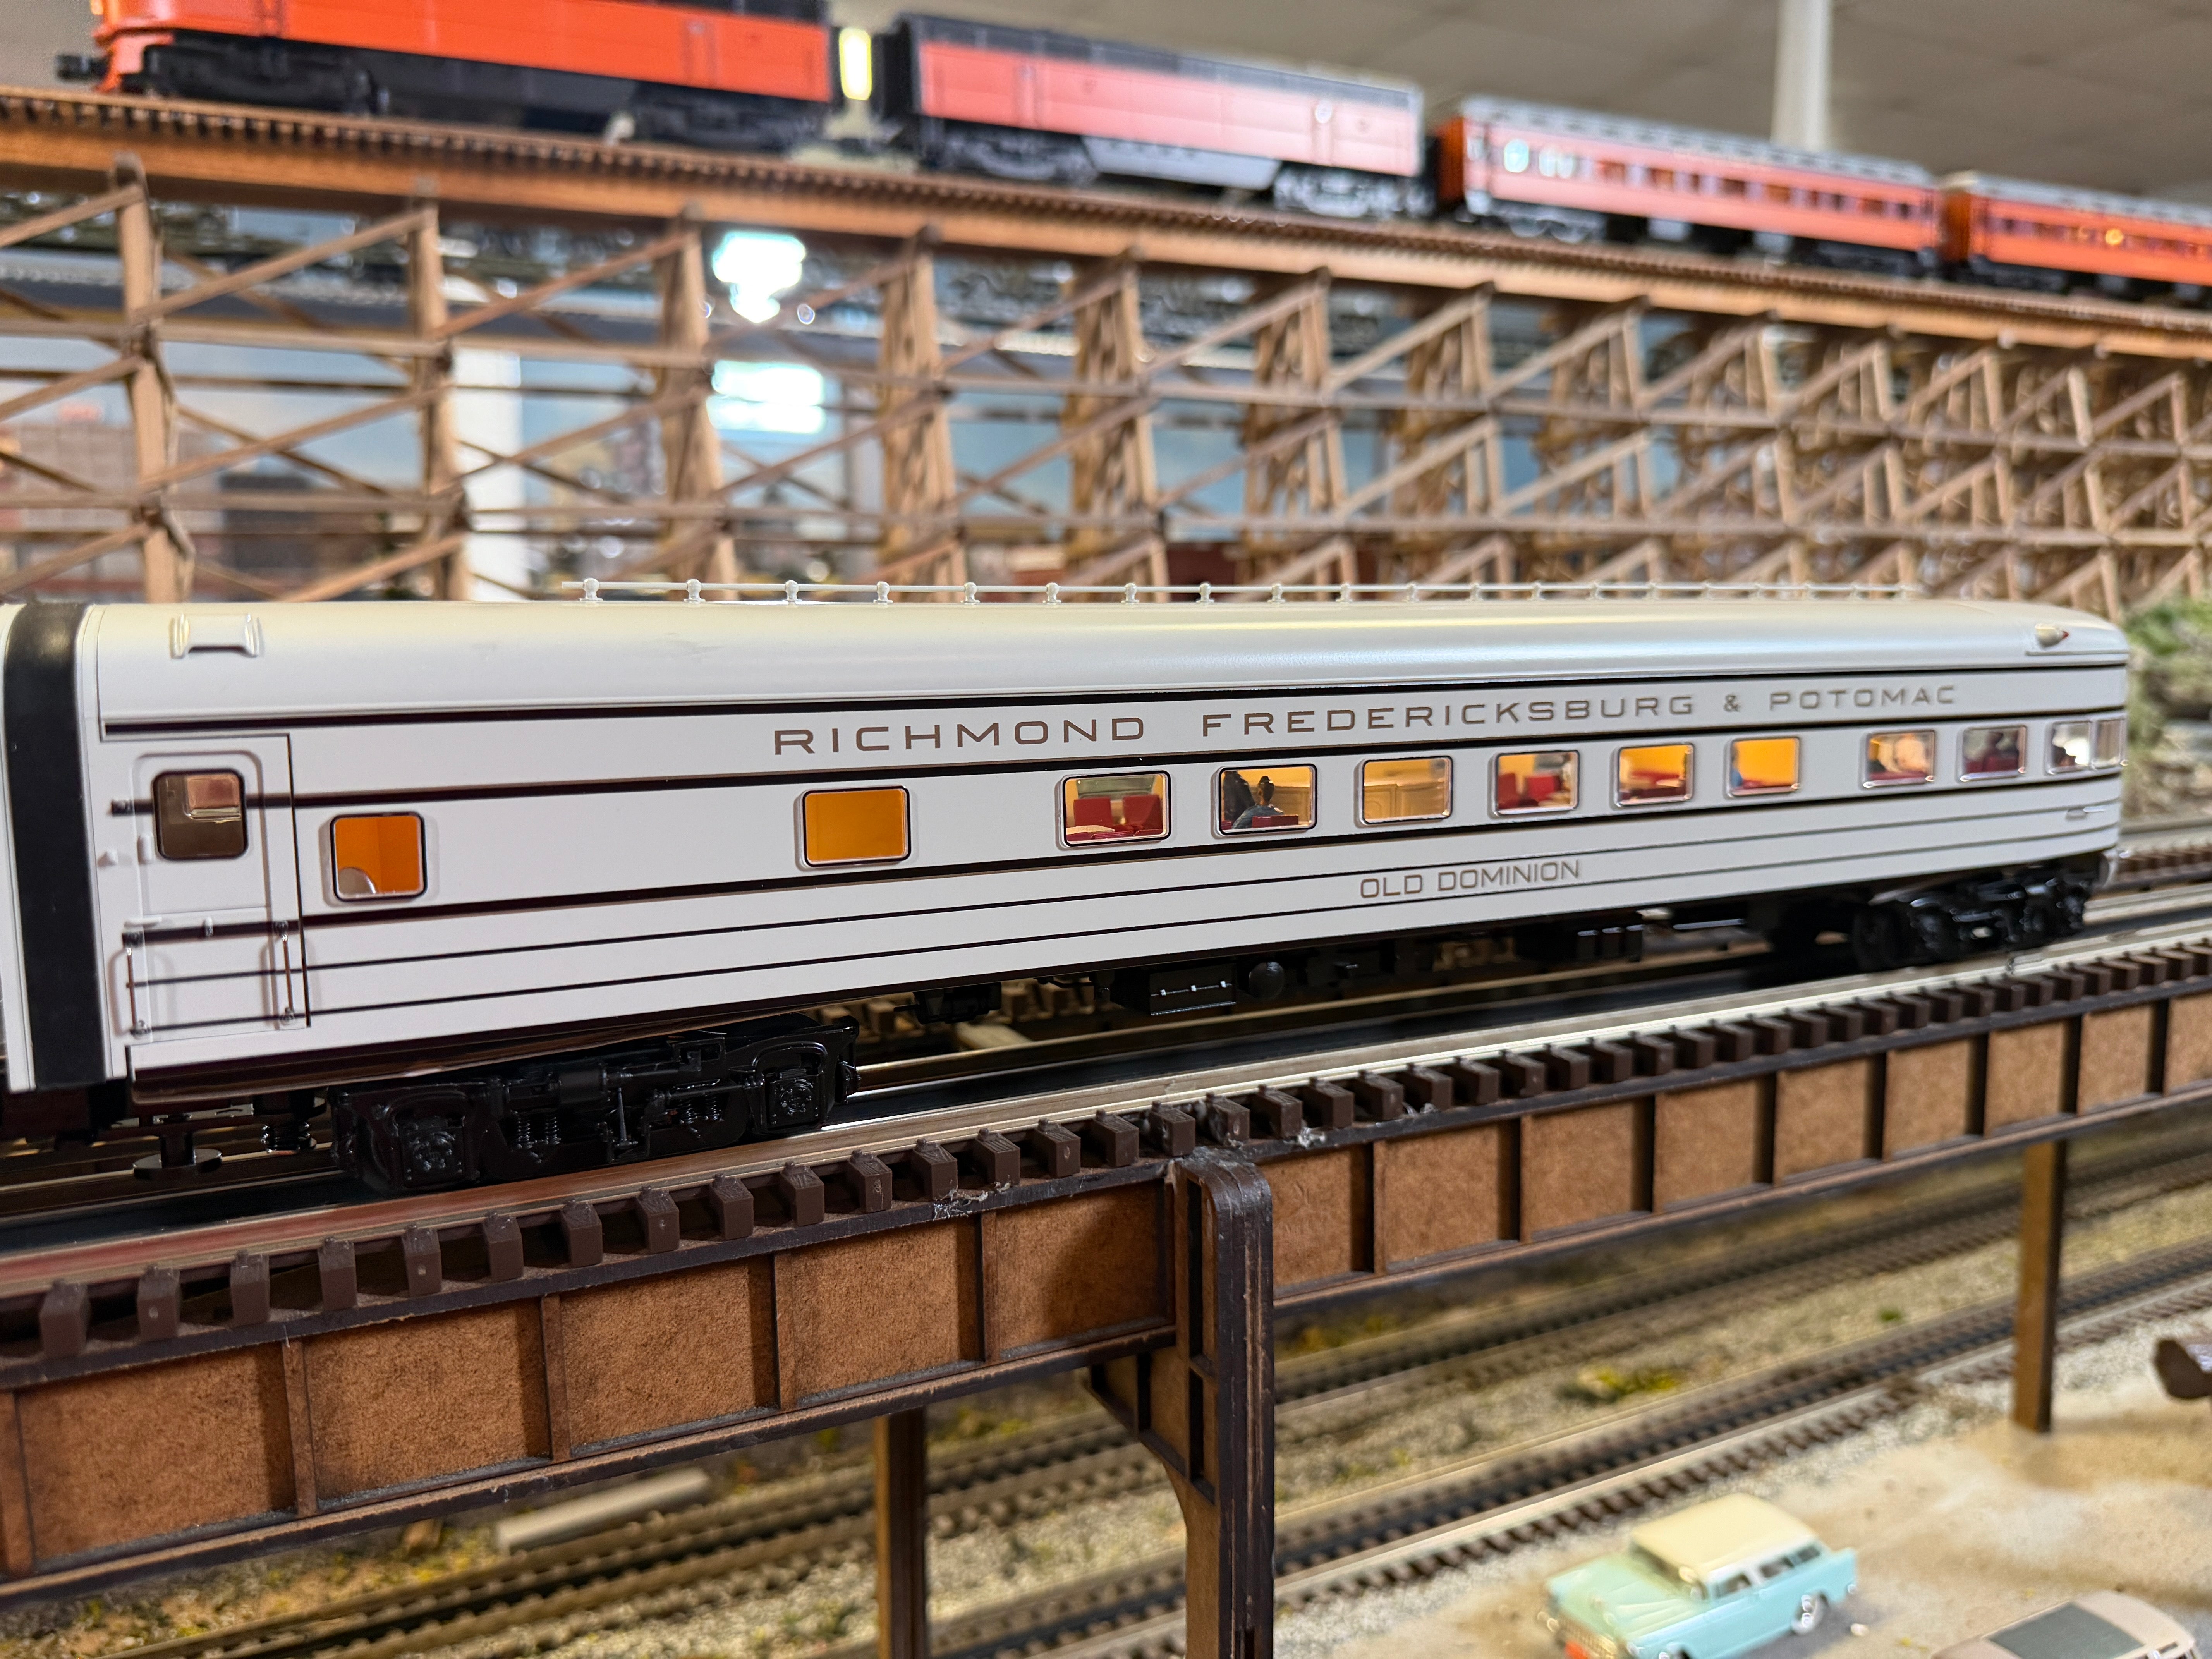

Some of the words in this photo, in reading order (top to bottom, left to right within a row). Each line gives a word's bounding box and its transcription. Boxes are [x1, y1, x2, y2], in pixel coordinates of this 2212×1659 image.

[774, 717, 1144, 756] RICHMOND
[1202, 696, 1693, 737] FREDERICKSBURG
[1723, 694, 1740, 713] &
[1769, 686, 1954, 710] POTOMAC
[1360, 874, 1424, 899] OLD
[1438, 860, 1580, 892] DOMINION
